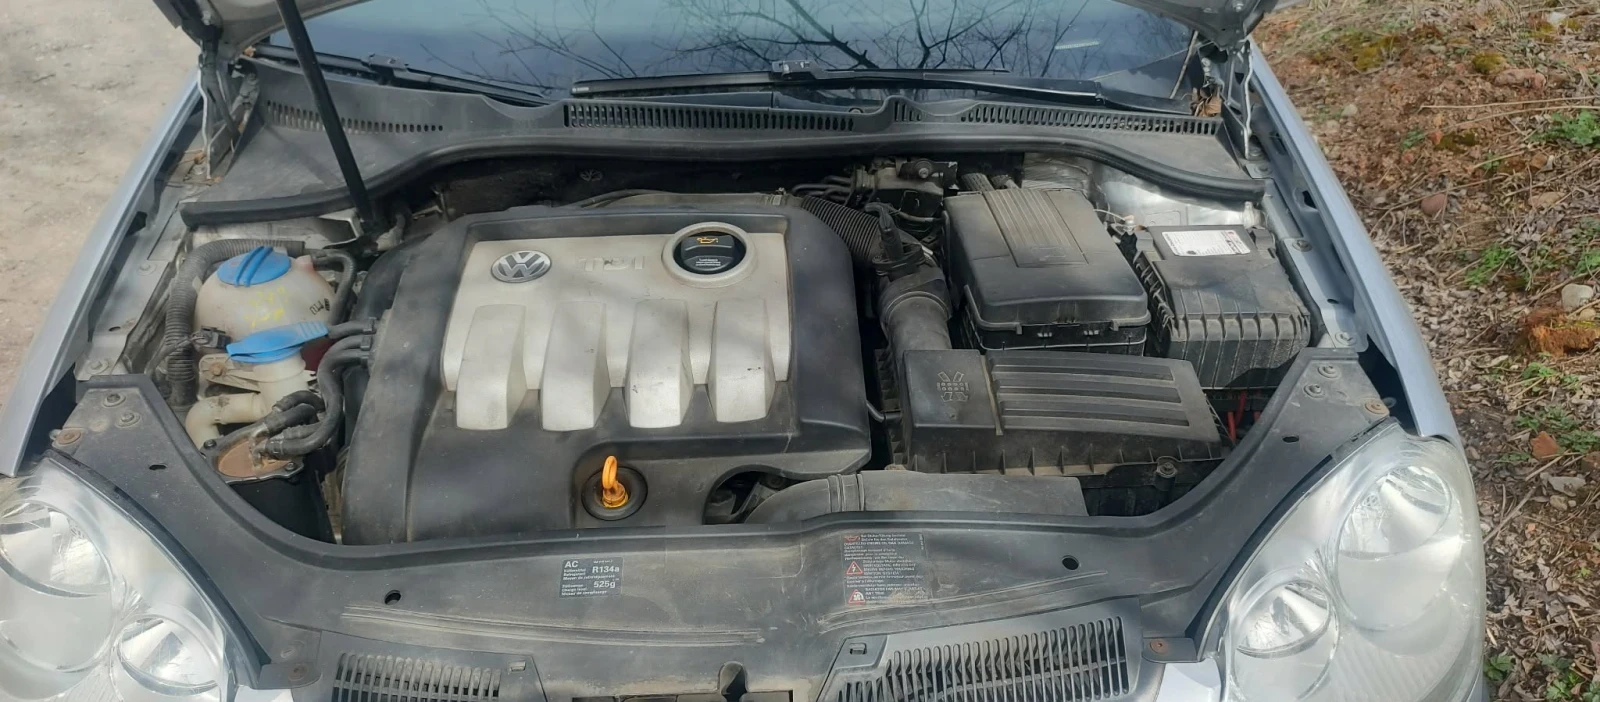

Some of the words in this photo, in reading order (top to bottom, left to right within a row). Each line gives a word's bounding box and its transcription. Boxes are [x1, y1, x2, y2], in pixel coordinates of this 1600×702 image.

[491, 250, 552, 283] VW
[564, 560, 579, 568] AC
[592, 565, 620, 573] R134a
[593, 580, 616, 589] 525g
